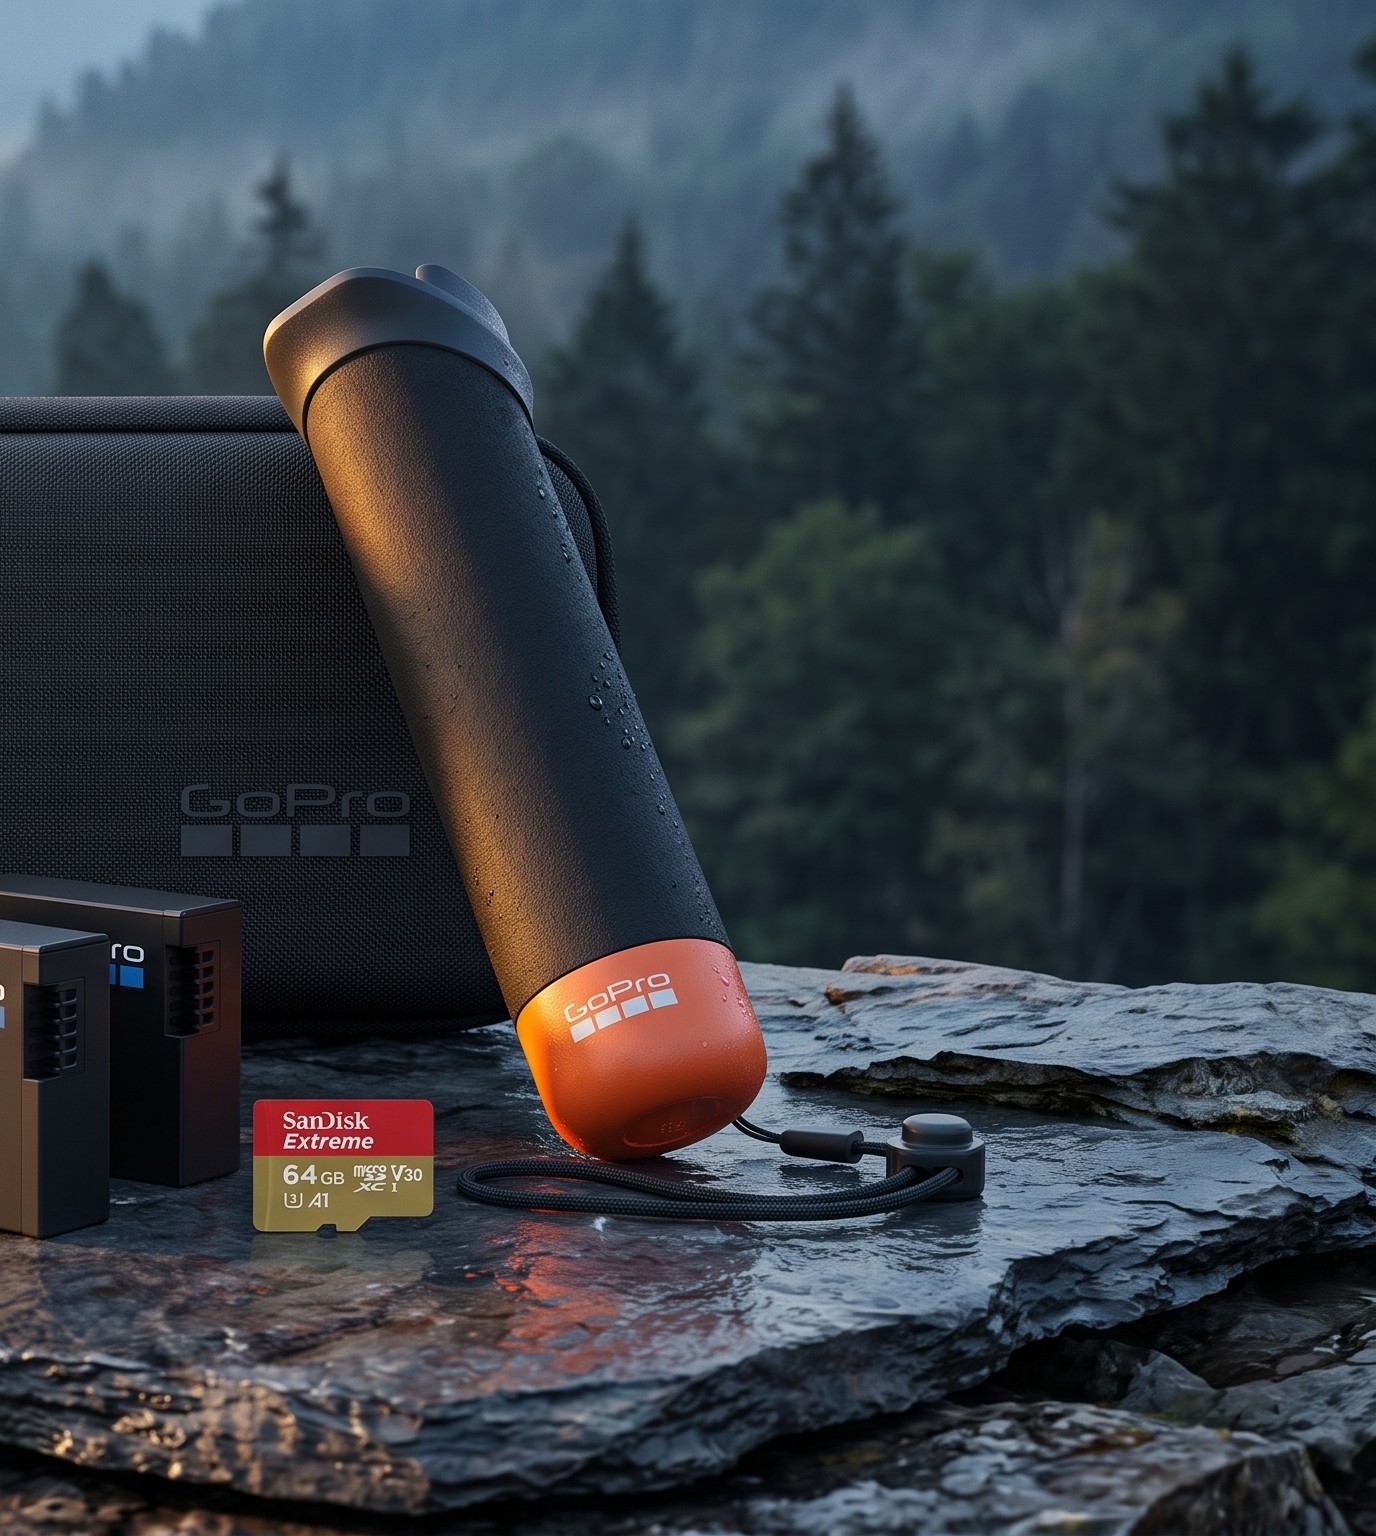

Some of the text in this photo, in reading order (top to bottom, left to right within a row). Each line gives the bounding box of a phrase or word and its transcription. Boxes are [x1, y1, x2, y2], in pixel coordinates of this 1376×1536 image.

[180, 783, 411, 818] GoPro
[563, 973, 671, 1023] GoPro
[282, 1111, 370, 1130] SanDisk
[282, 1133, 374, 1150] Extreme
[282, 1164, 317, 1185] 64
[320, 1171, 345, 1185] GB
[390, 1164, 423, 1182] V30
[307, 1192, 329, 1208] A1
